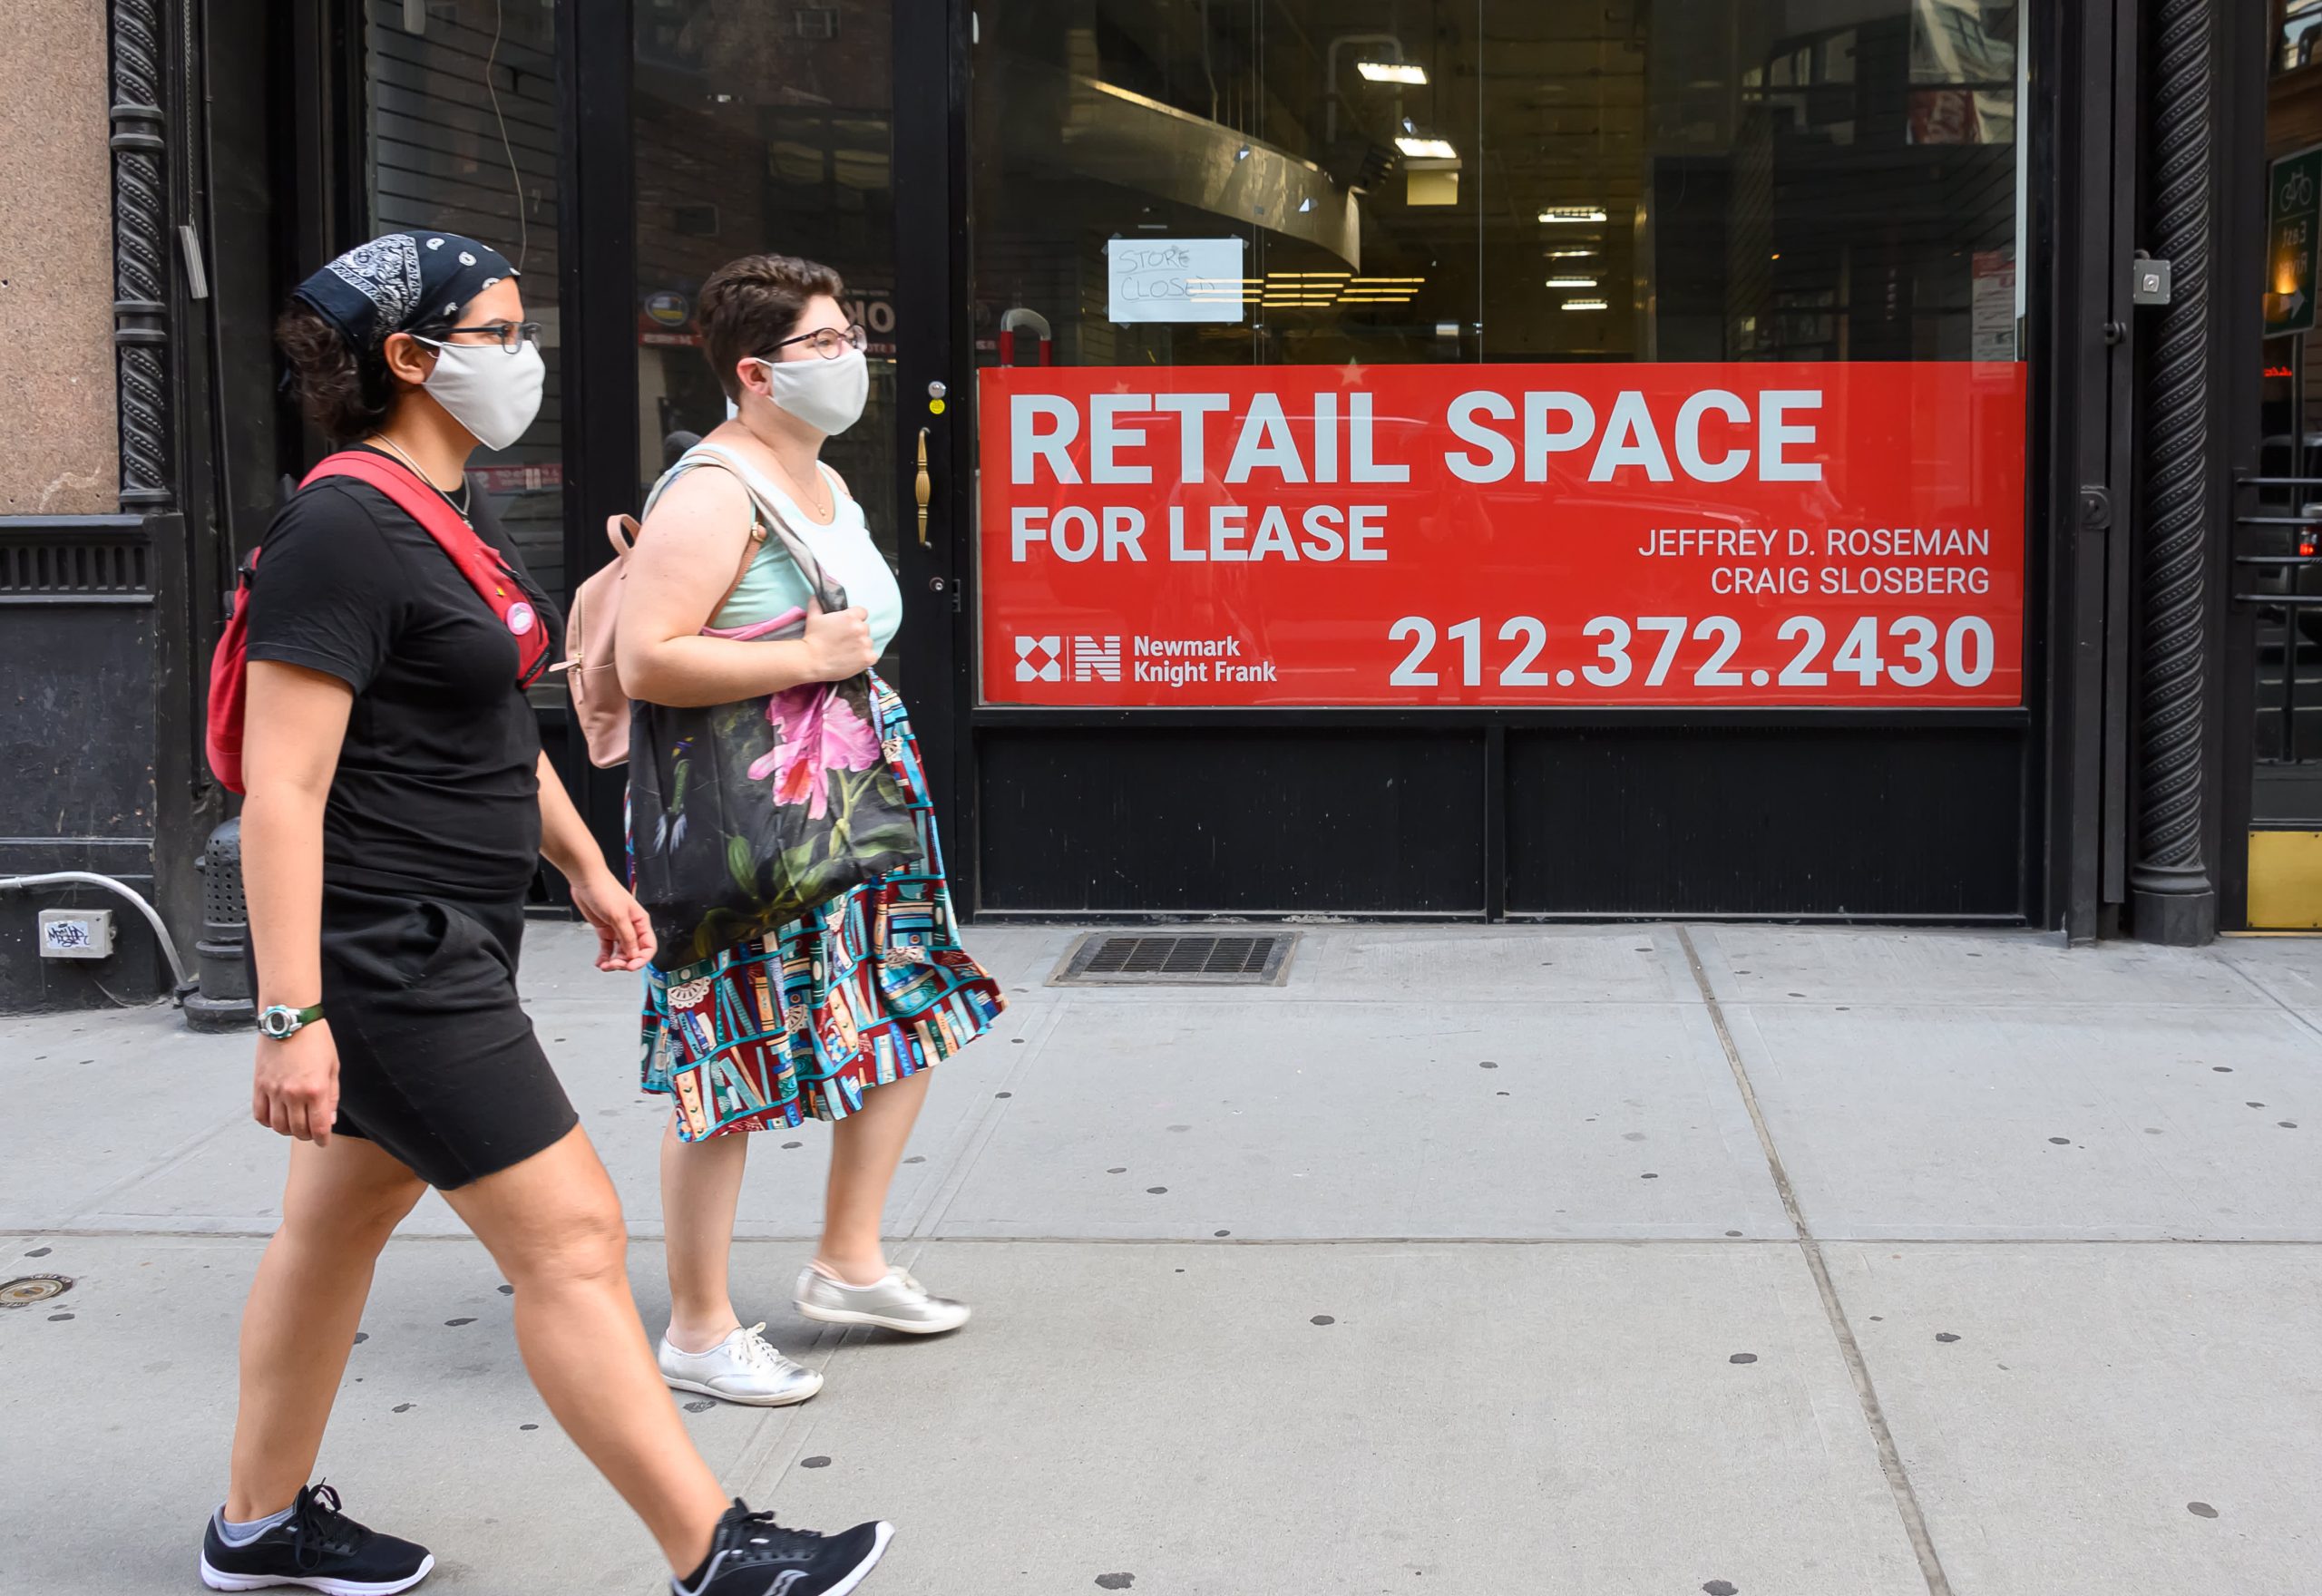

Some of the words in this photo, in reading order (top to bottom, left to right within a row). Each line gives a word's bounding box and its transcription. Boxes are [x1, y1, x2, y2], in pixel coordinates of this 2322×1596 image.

[1117, 248, 1190, 273] STORE
[1010, 392, 1410, 485] RETAIL
[1444, 390, 1822, 484] SPACE
[1010, 505, 1147, 563] FOR
[1169, 504, 1388, 562] LEASE
[1638, 529, 1779, 557] JEFFREY
[1789, 529, 1815, 556] D.
[1828, 529, 1989, 556] ROSEMAN
[1712, 567, 1809, 594] CRAIG
[1820, 567, 1989, 594] SLOSBERG
[1134, 635, 1241, 657] Newmark
[1388, 615, 1995, 687] 212.372.2430
[1134, 659, 1208, 687] Knight
[1215, 660, 1278, 682] Frank
